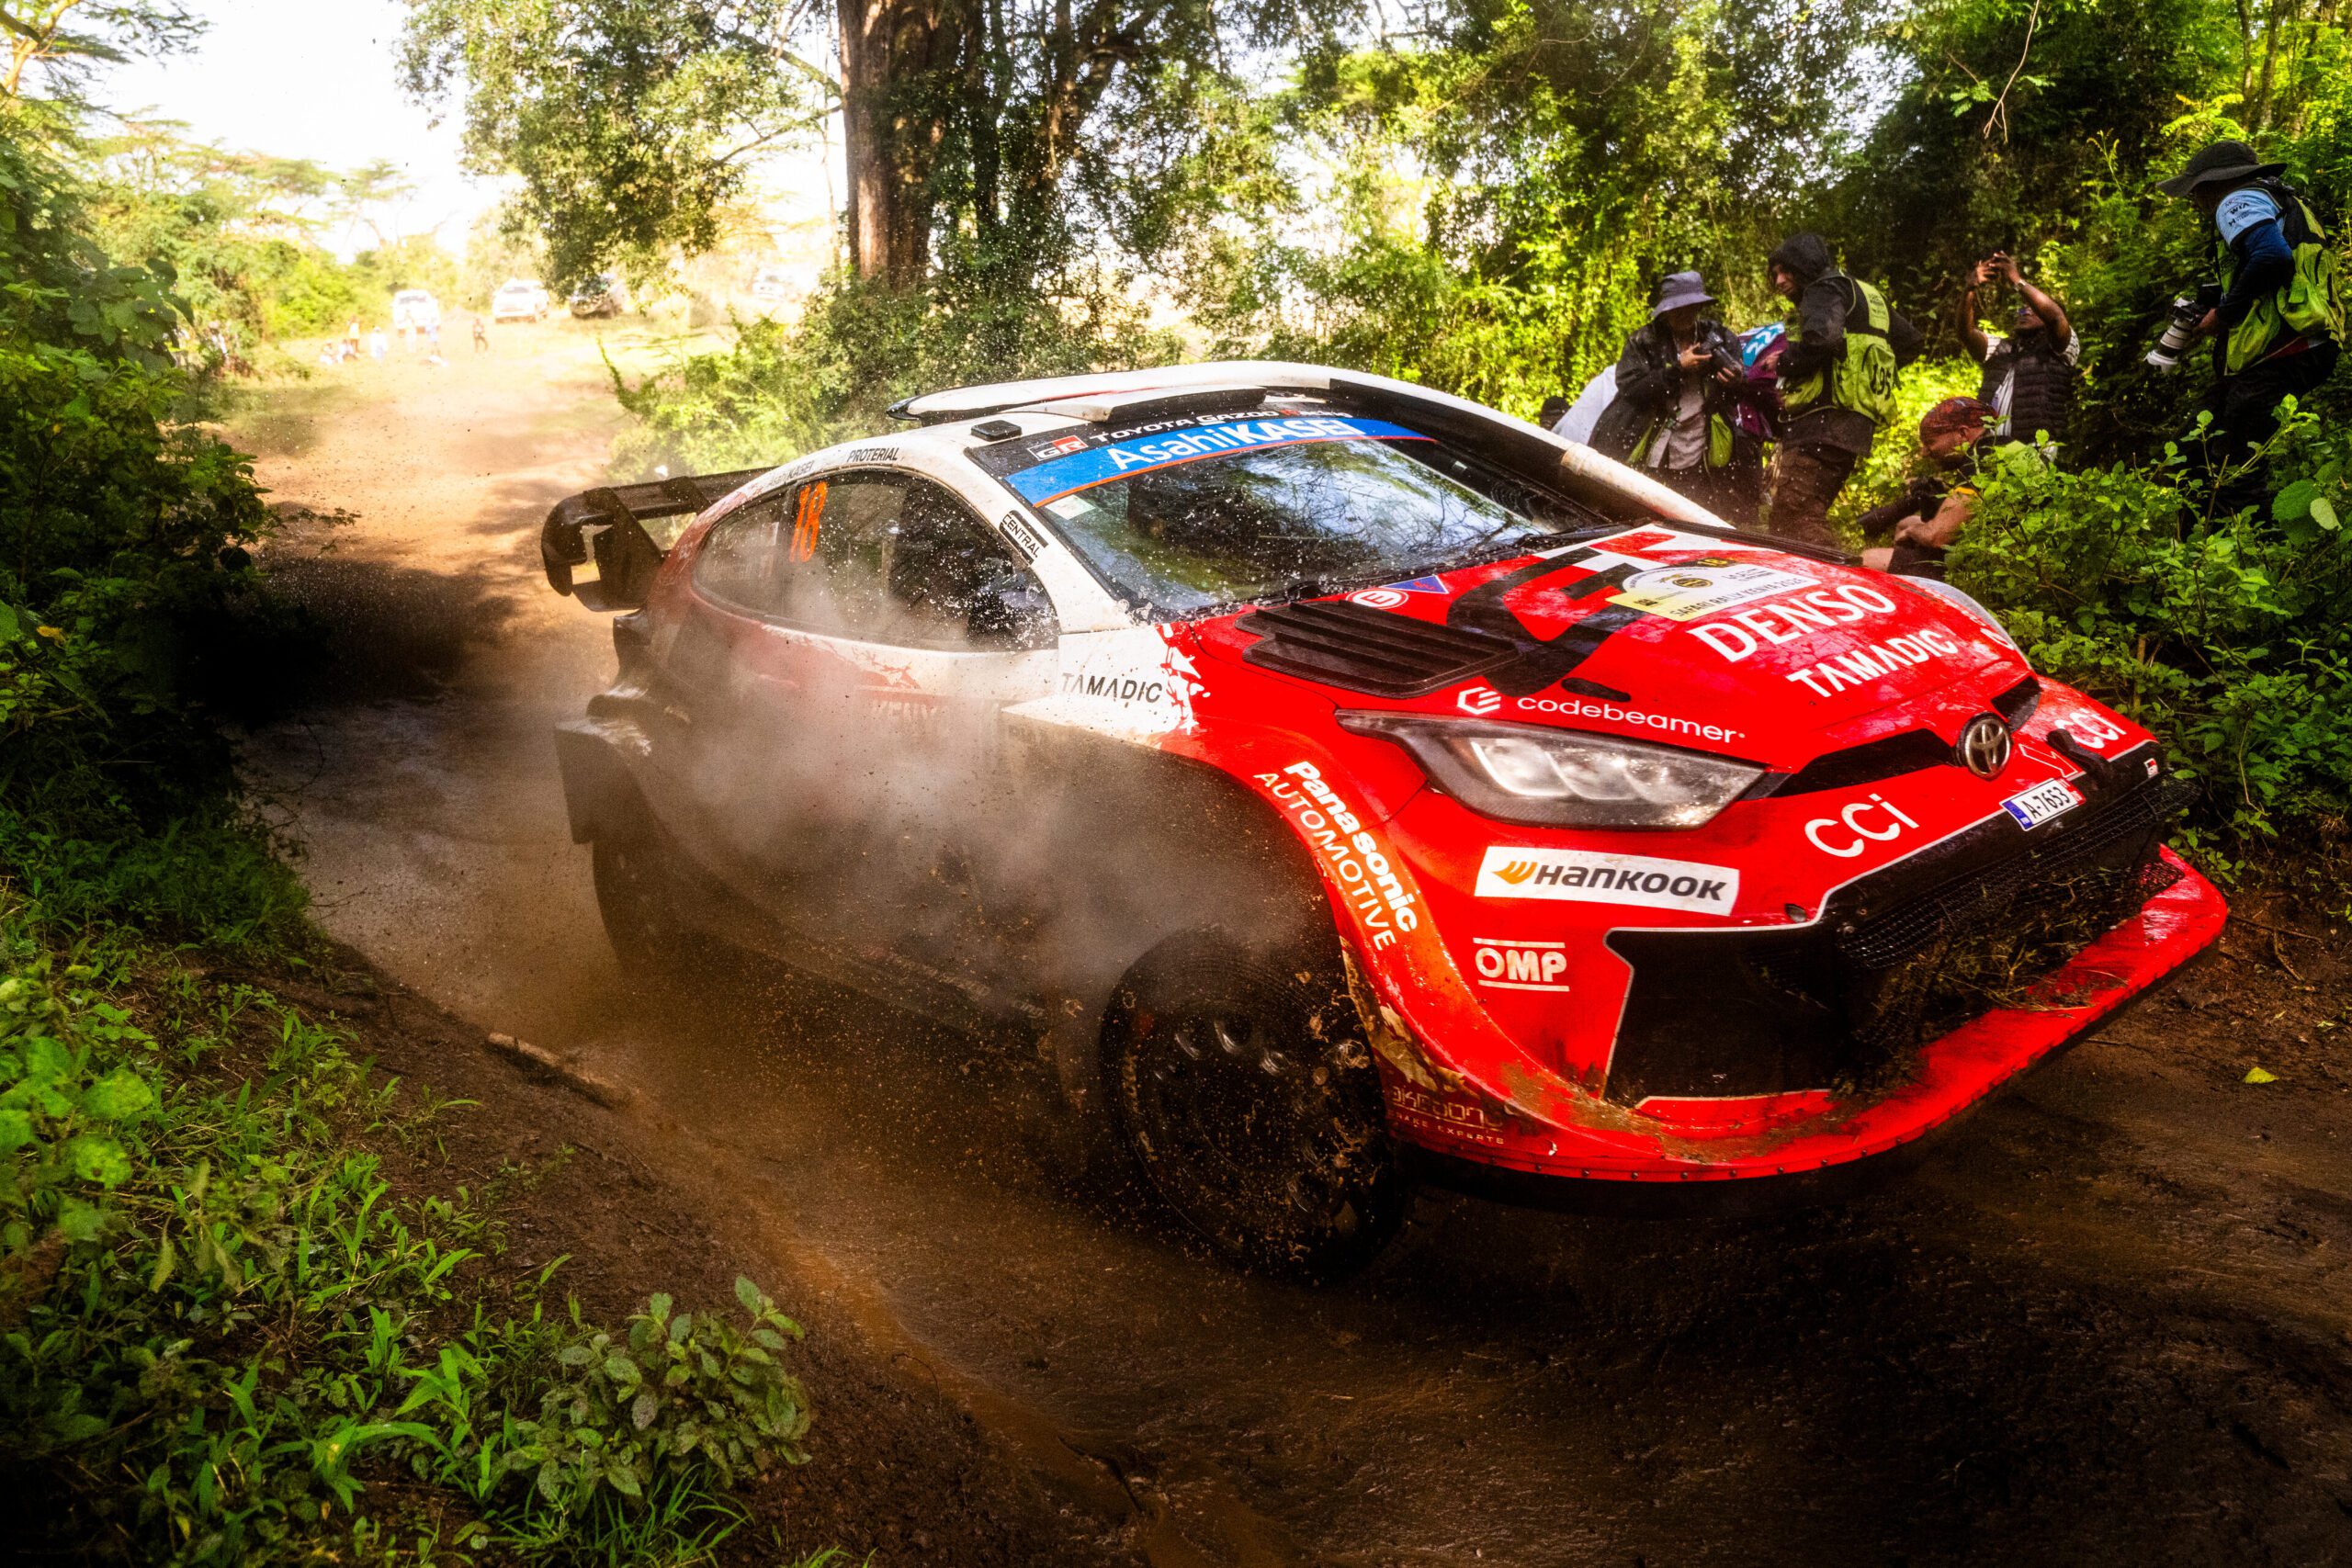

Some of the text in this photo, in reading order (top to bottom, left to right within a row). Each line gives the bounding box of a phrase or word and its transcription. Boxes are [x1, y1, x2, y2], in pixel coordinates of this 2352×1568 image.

[1090, 417, 1193, 442] TOYOTA
[1196, 410, 1278, 425] GAZOO
[1106, 420, 1365, 470] AsahiKASEI
[847, 447, 899, 461] PROTERIAL
[1036, 441, 1087, 459] GR
[789, 480, 828, 563] 18
[1002, 513, 1039, 558] CENTRAL
[1669, 598, 1715, 617] SAFARI
[1714, 591, 1744, 607] RALLY
[1743, 581, 1780, 599] KENYA
[1688, 584, 1896, 662] DENSO
[1786, 630, 1958, 698] TAMADIC
[1061, 673, 1162, 704] TAMADIC
[1517, 694, 1737, 744] codebeamer
[2021, 786, 2071, 819] A-7653
[1283, 761, 1418, 932] Panasonic
[1804, 793, 1920, 860] CCi
[1253, 773, 1397, 952] AUTOMOTIVE
[1476, 947, 1567, 984] OMP
